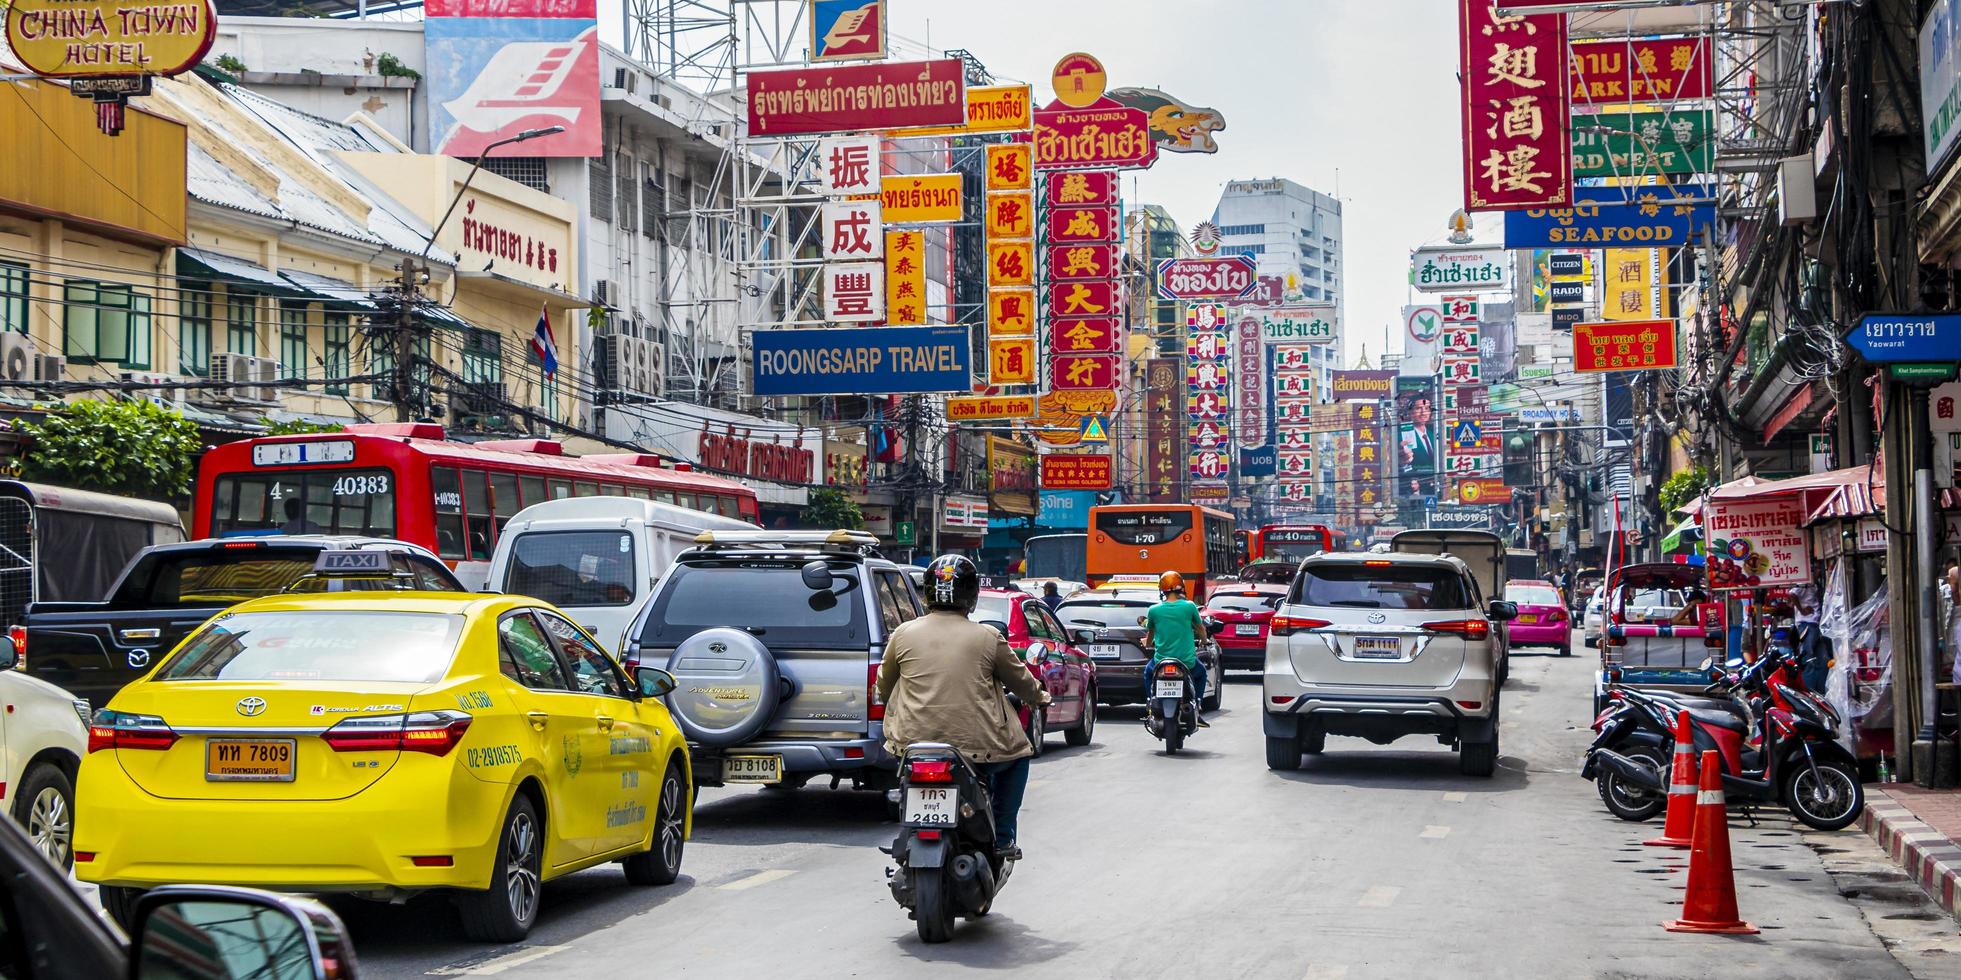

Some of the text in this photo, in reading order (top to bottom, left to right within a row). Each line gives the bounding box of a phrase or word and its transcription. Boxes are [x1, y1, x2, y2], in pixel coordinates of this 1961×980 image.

[19, 5, 199, 40] CHINA TOWN
[65, 43, 151, 65] HOTEL
[1632, 78, 1672, 95] FIN
[754, 62, 957, 130] รุ่งทรัพย์การท่องเที่ยว
[829, 145, 874, 316] 振成豐
[1548, 226, 1673, 242] SEAFOOD
[1551, 261, 1581, 269] CITIZEN
[1169, 263, 1249, 293] ทองใบ
[1552, 286, 1582, 296] RADO
[1556, 313, 1579, 321] MIDO
[1866, 320, 1936, 337] เยาวราช
[1868, 340, 1905, 348] Yaowarat
[759, 345, 962, 376] ROONGSARP TRAVEL
[298, 444, 308, 463] 1
[1251, 456, 1273, 465] UOB
[270, 481, 282, 500] 4
[332, 475, 388, 496] 40383
[1284, 532, 1299, 541] 40
[329, 554, 378, 567] TAXI
[362, 704, 403, 712] ALTIS
[250, 745, 289, 762] 7809
[746, 759, 776, 771] 8108
[920, 789, 947, 800] 1กจ
[912, 813, 949, 824] 2493
